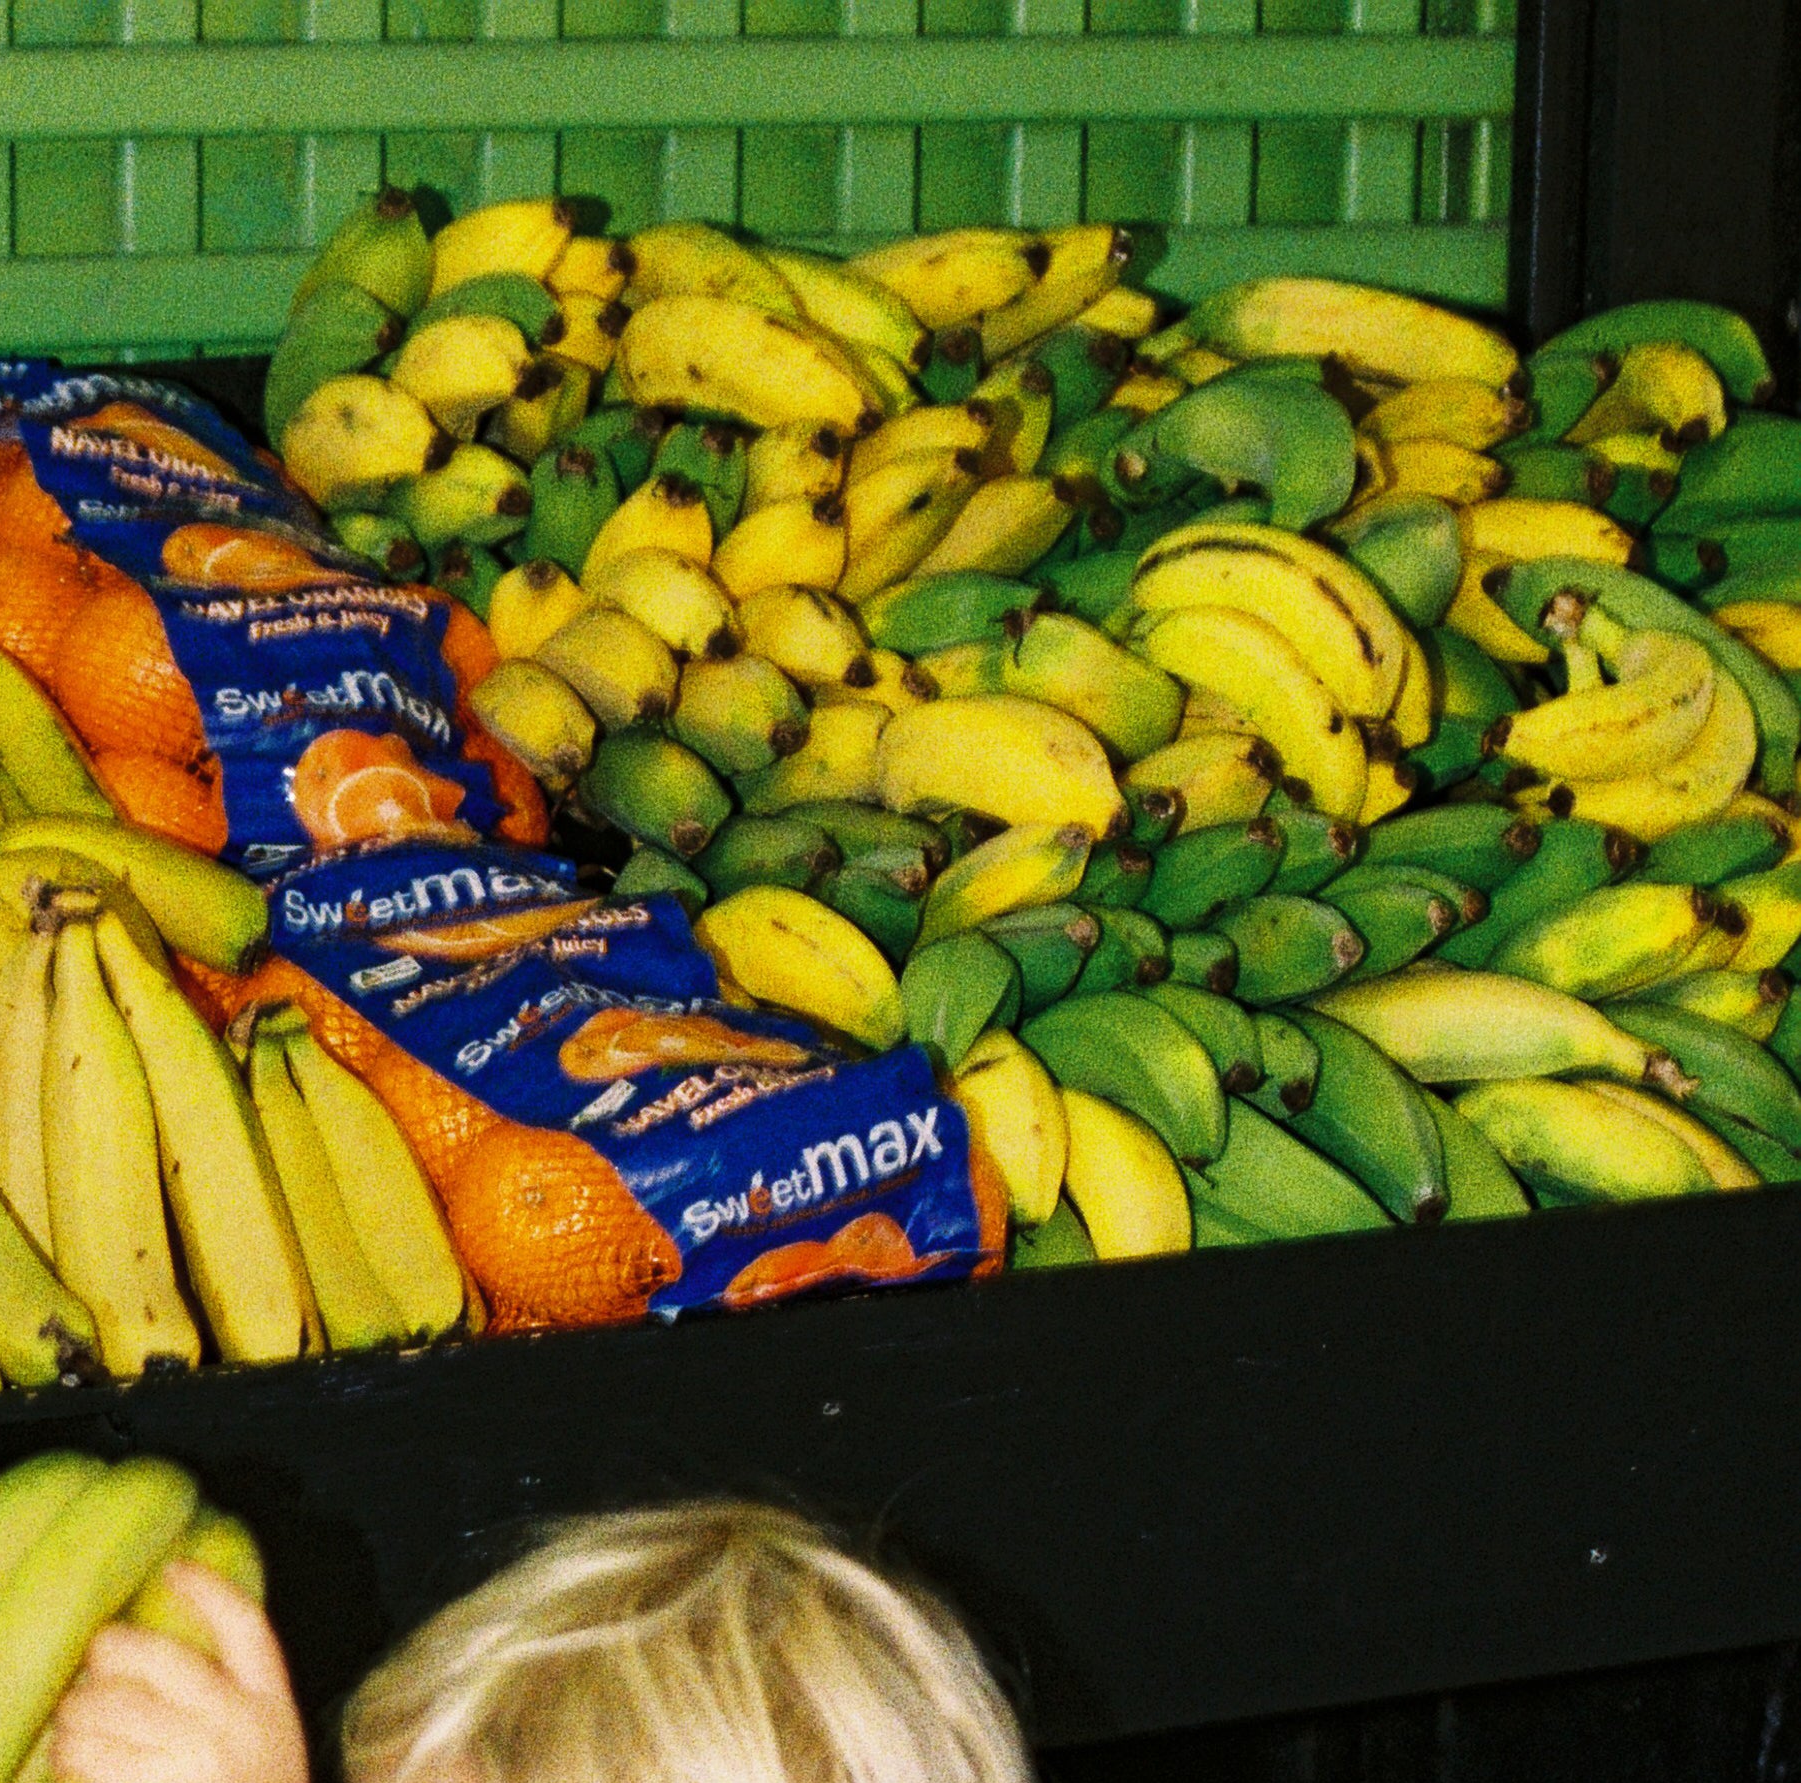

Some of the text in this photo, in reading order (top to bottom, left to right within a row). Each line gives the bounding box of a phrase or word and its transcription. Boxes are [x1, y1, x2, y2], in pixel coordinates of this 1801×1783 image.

[247, 611, 310, 644] Fresh
[338, 605, 393, 639] Juicy
[681, 1106, 944, 1244] Sweetmax
